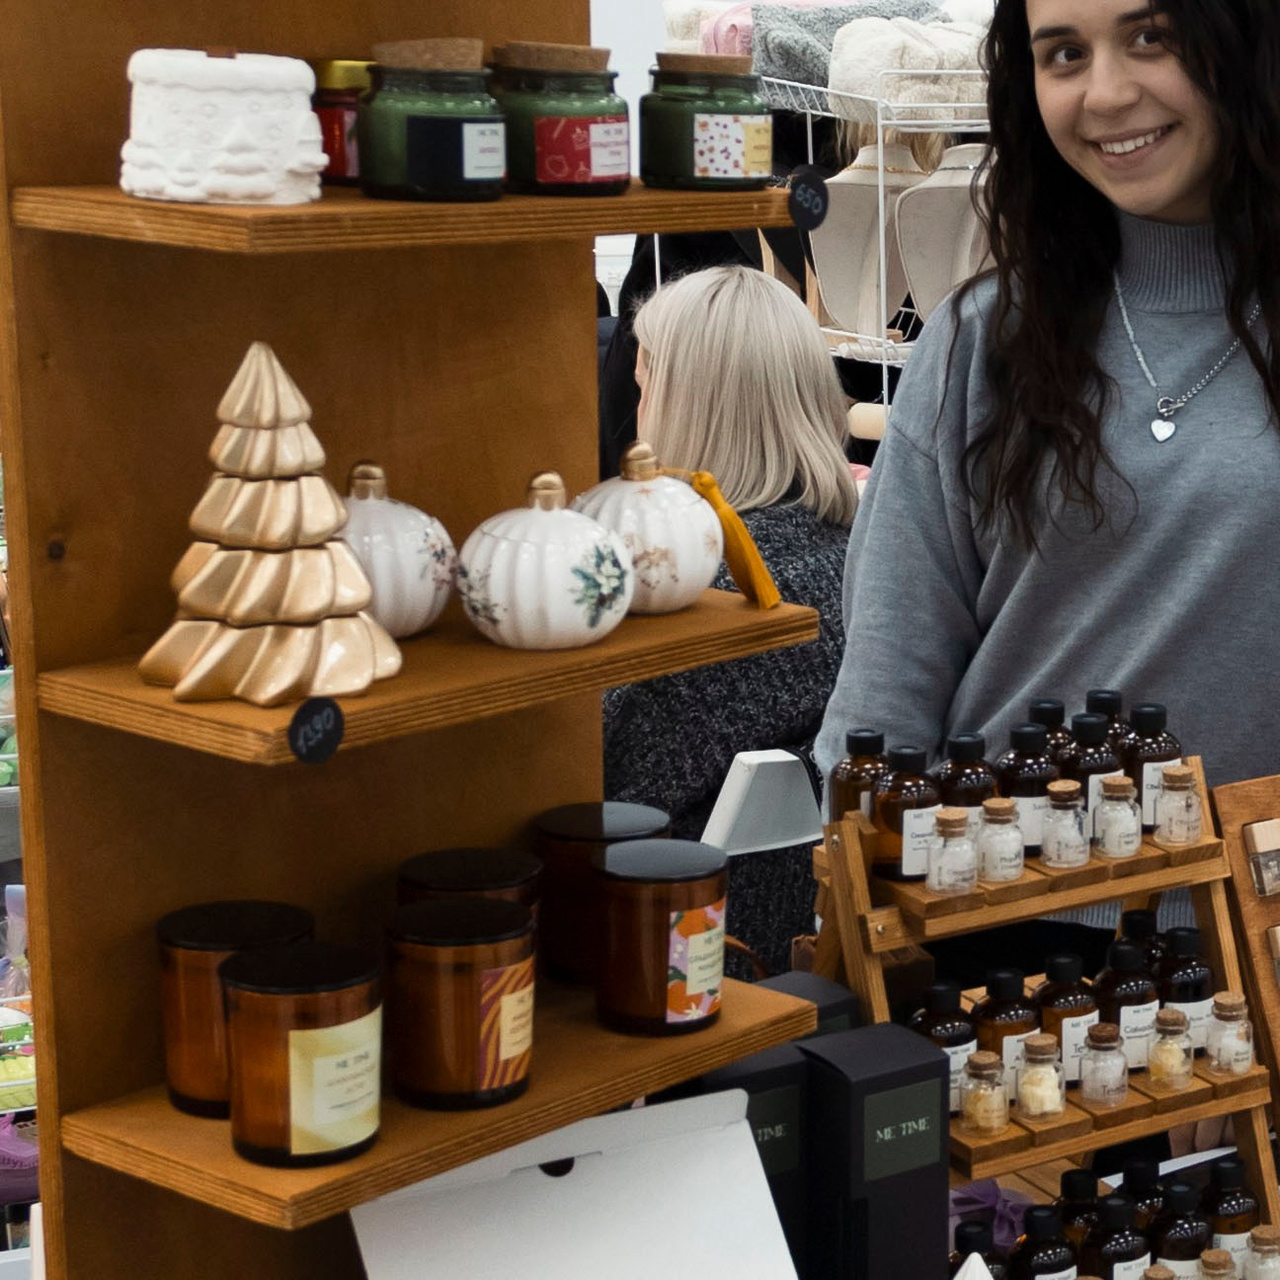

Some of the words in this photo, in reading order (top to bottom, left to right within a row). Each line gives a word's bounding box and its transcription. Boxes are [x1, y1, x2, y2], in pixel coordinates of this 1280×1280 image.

[795, 183, 823, 215] 650
[756, 1123, 788, 1142] TIME
[875, 1125, 897, 1143] ME
[899, 1117, 931, 1137] TIME
